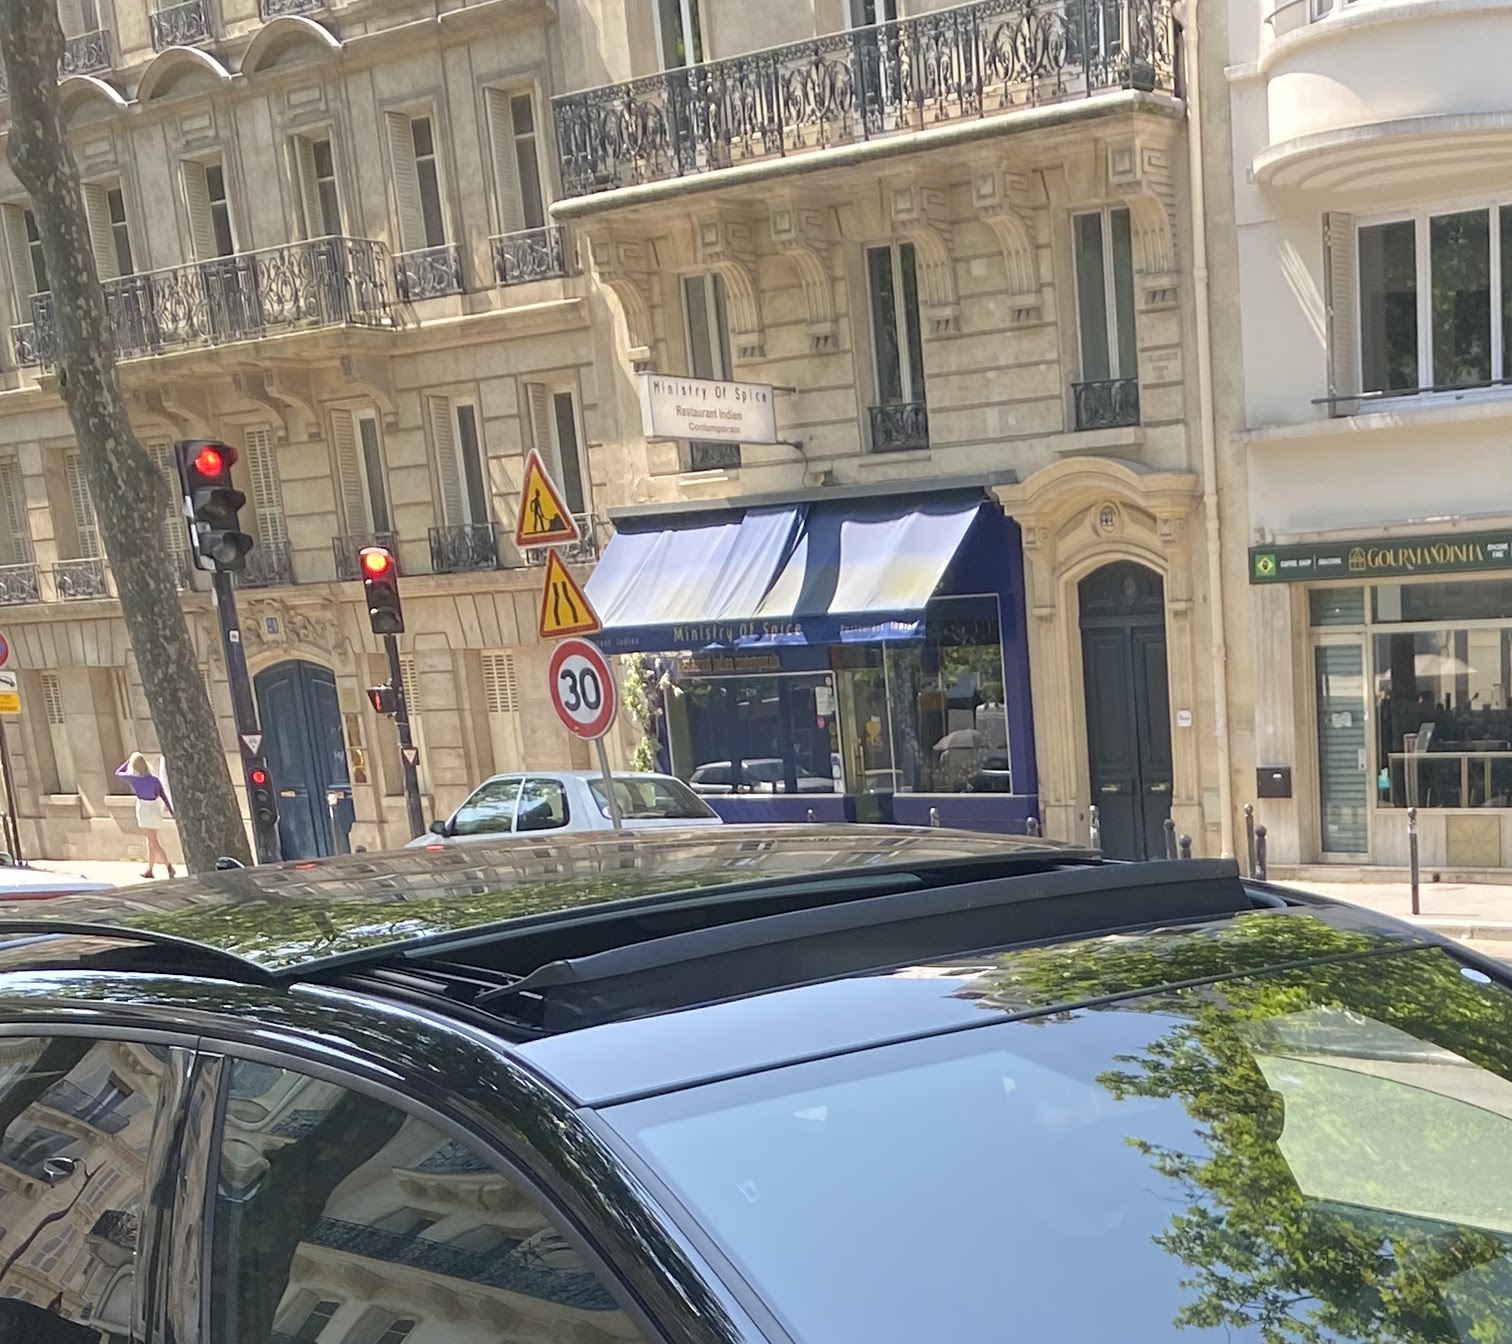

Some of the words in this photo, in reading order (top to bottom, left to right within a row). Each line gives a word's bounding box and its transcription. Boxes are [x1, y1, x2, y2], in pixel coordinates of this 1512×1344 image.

[653, 381, 706, 401] Ministry
[715, 385, 727, 399] Of
[735, 387, 767, 404] Spice
[676, 405, 717, 419] Restaurant
[673, 623, 734, 643] Ministry
[560, 666, 601, 712] 30
